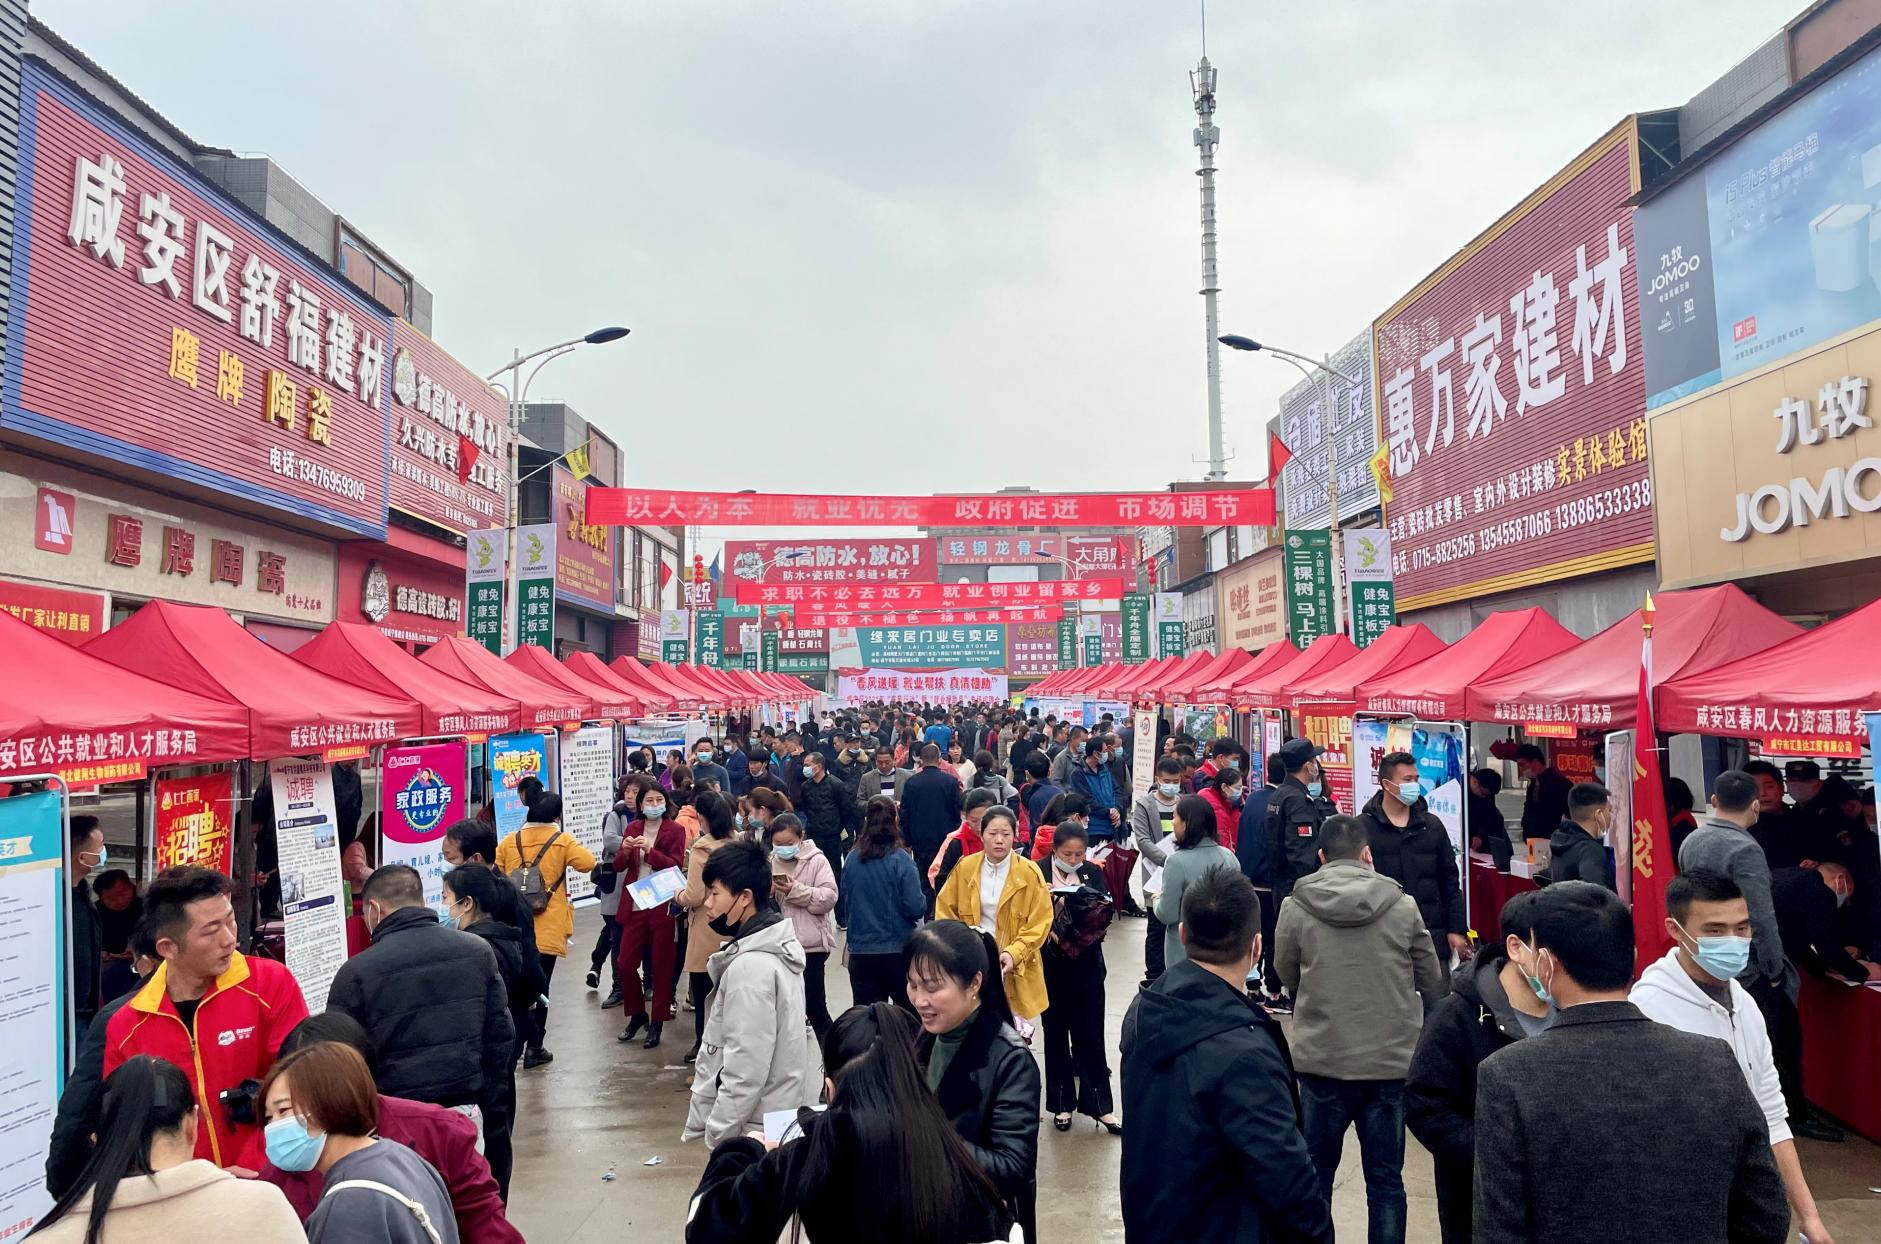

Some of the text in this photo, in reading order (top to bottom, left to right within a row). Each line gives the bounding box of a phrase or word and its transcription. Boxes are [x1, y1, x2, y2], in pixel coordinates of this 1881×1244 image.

[1647, 255, 1700, 295] JOMOO
[1660, 246, 1682, 270] 九牧
[67, 152, 385, 410] 咸安区舒福建材
[1384, 221, 1629, 480] 惠万家建材
[168, 326, 333, 446] 鹰牌陶瓷
[1773, 376, 1873, 454] 九牧
[270, 446, 365, 502] 电话:13476959309
[400, 416, 503, 495] 久兴防水专工服务
[1557, 417, 1648, 488] 实景体验馆
[625, 494, 1240, 520] 以人为本 就业优先 政府促进 市场调节
[1413, 534, 1475, 570] 0715-8825256
[1480, 509, 1551, 551] 13545587066
[1556, 479, 1651, 529] 13886533338
[949, 540, 1054, 557] 轻钢龙骨厂
[1316, 551, 1325, 584] 大国品牌
[943, 582, 1101, 598] 就业创业留家乡
[1293, 551, 1313, 596] 三棵树
[477, 589, 488, 648] 健康板材
[488, 588, 499, 634] 兔宝宝
[527, 586, 539, 647] 健康板材
[539, 586, 550, 632] 兔宝宝
[812, 609, 1048, 626] 退役不褪色 扬帆再起航
[1377, 588, 1391, 632] 兔宝宝
[870, 629, 999, 644] 缘来居门业专卖店
[1129, 608, 1142, 656] 千年舟全屋定制
[903, 676, 945, 690] 就业帮扶
[0, 730, 197, 770] 安区公共就业和人才服务局
[290, 720, 396, 749] 咸安区公共就业和人才服务局
[287, 777, 315, 801] 诚聘
[396, 786, 452, 811] 家政服务
[166, 802, 222, 865] 招聘
